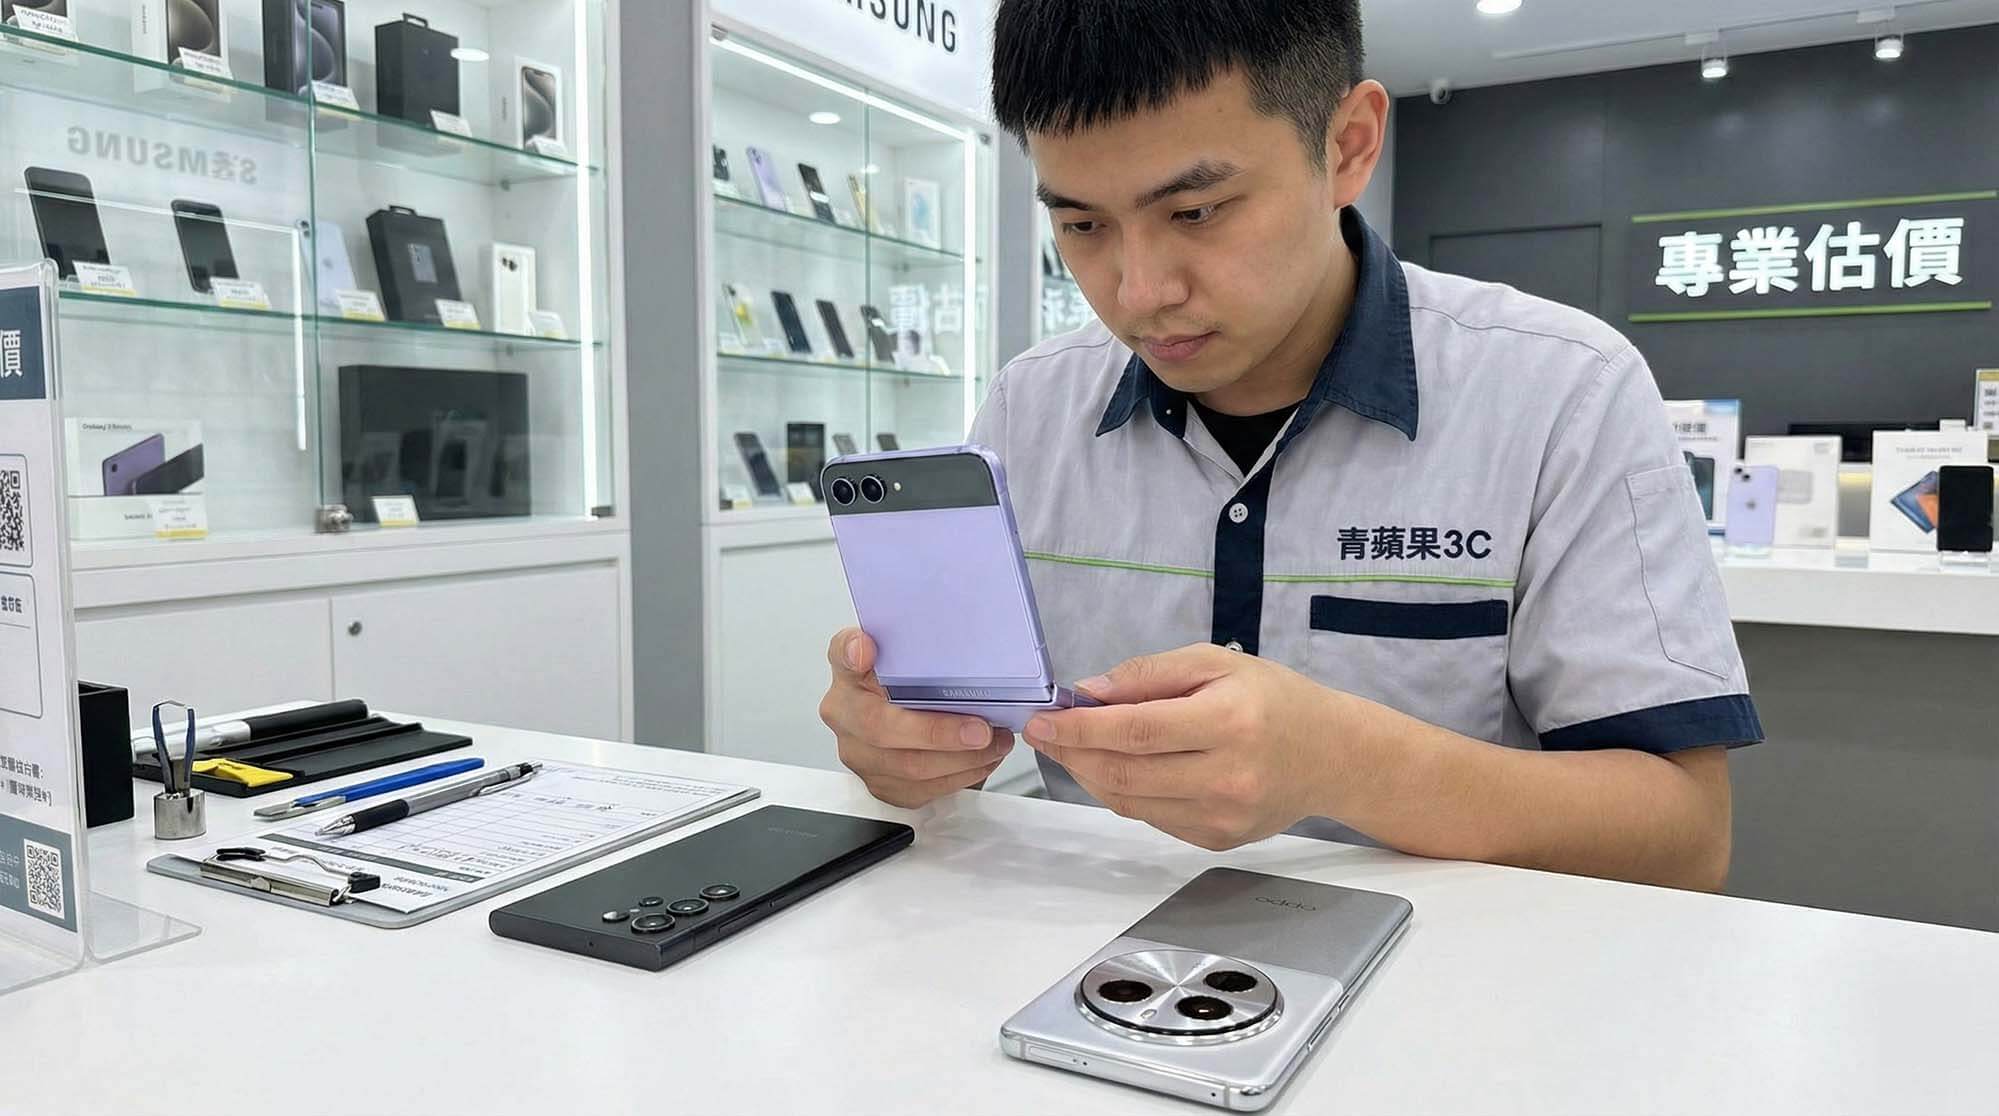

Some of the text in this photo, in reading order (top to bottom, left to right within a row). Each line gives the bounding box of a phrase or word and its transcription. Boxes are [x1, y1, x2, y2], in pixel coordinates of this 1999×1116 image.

[845, 0, 956, 53] SUNG
[1655, 217, 1965, 297] 專業估價
[1337, 526, 1492, 560] 青蘋果3C
